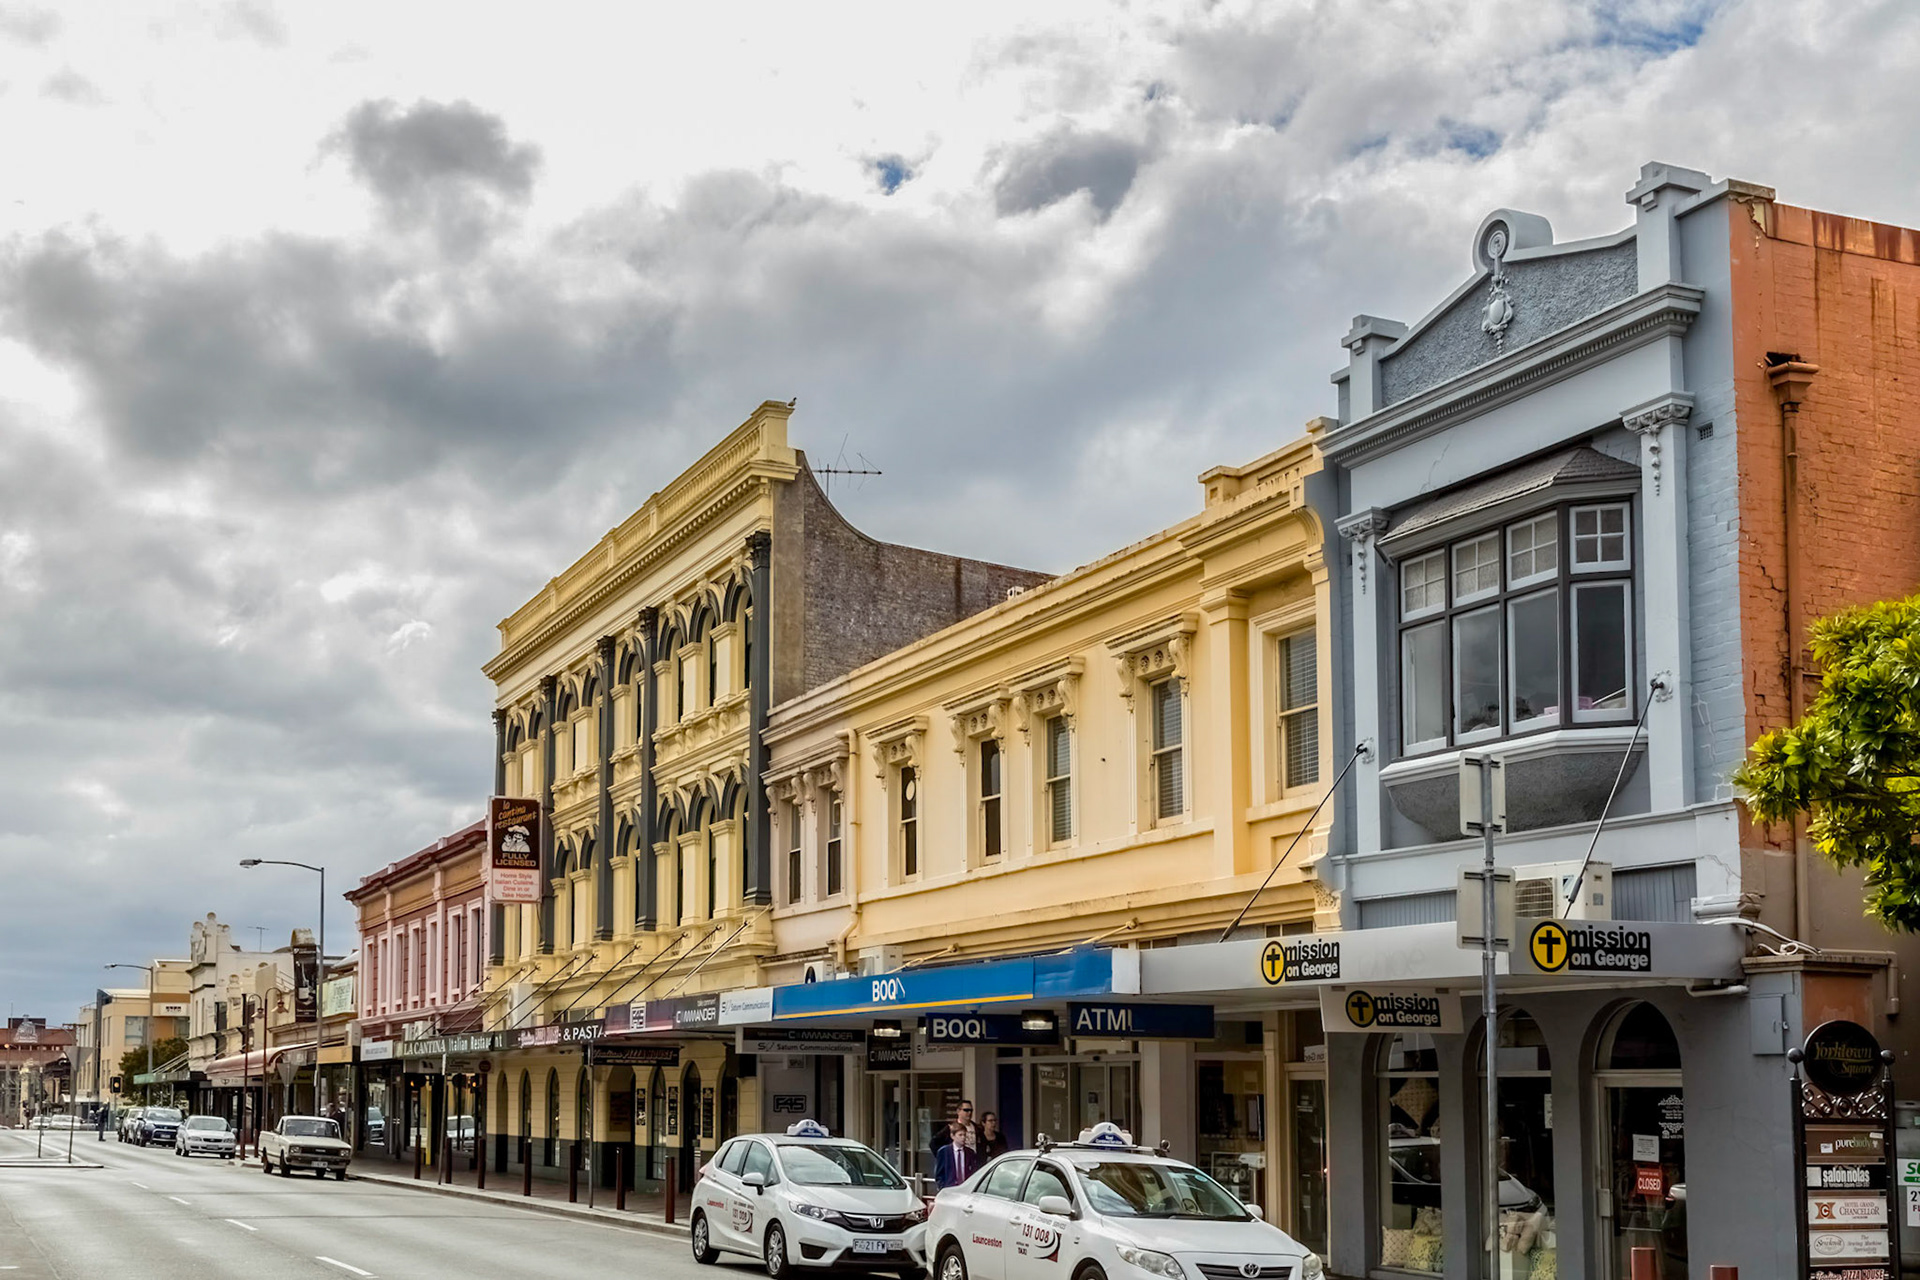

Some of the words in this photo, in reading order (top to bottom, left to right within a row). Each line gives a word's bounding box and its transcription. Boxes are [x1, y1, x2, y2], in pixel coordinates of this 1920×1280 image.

[494, 810, 537, 830] restaurant
[495, 859, 536, 867] LICENSED
[1567, 925, 1650, 949] mission
[1284, 938, 1340, 962] mission
[1571, 952, 1591, 966] on
[1594, 949, 1648, 970] George
[1286, 964, 1299, 977] on
[1301, 961, 1338, 978] George
[872, 978, 896, 1002] BOQ
[1374, 992, 1439, 1010] mission
[1076, 1008, 1126, 1031] ATM
[1378, 1013, 1394, 1023] on
[1396, 1010, 1438, 1026] George
[563, 1028, 571, 1041] &
[932, 1018, 981, 1039] BOQ
[404, 1043, 414, 1056] LA
[414, 1038, 446, 1055] CANTINA
[449, 1035, 468, 1051] Italian
[470, 1033, 502, 1050] Restaunt
[800, 1044, 852, 1052] Communications
[1814, 1041, 1872, 1060] Yorktown
[1842, 1061, 1874, 1077] Square
[1638, 1178, 1660, 1190] CLOSED
[1910, 1190, 1920, 1202] 2
[1839, 1206, 1880, 1216] CHANCELLOR
[972, 1233, 1002, 1248] Launceston
[1022, 1224, 1034, 1238] 131
[1034, 1228, 1050, 1244] 008
